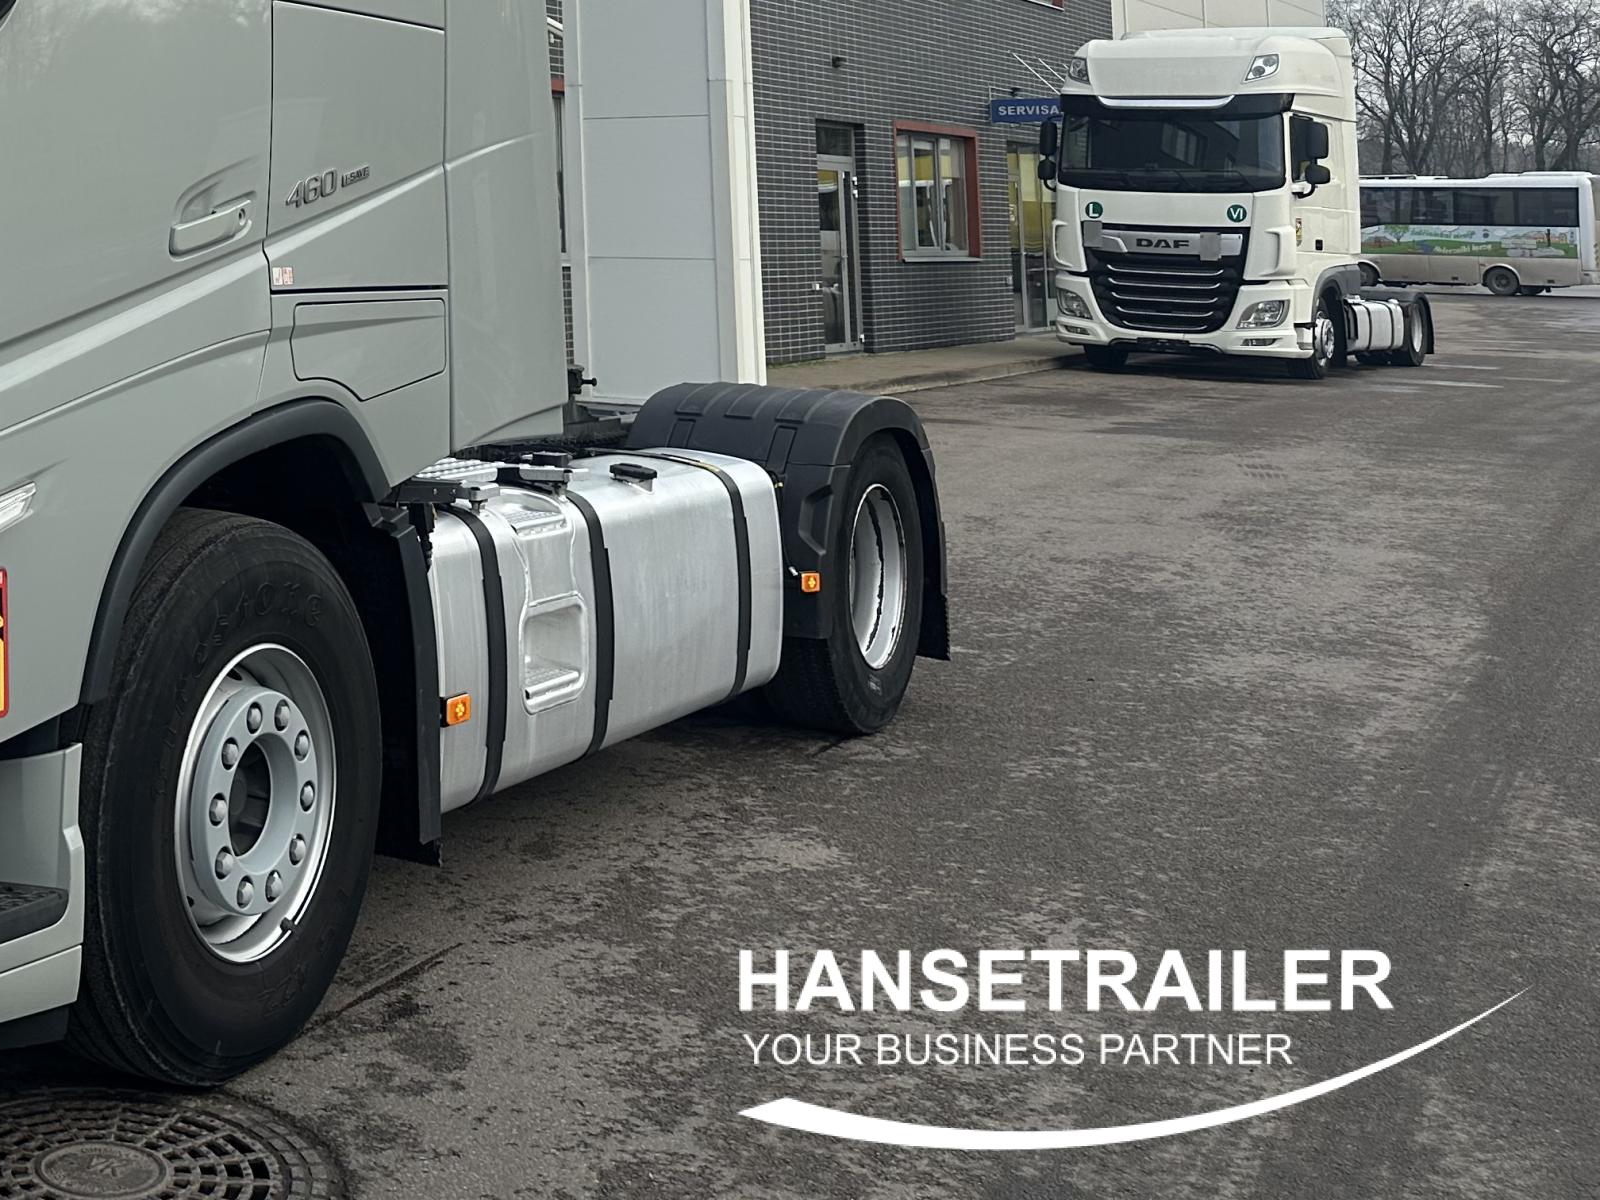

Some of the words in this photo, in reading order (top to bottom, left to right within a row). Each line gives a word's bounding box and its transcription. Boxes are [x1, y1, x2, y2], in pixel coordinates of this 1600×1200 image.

[286, 168, 338, 208] 460
[1088, 203, 1099, 218] L
[1135, 238, 1190, 249] DAF
